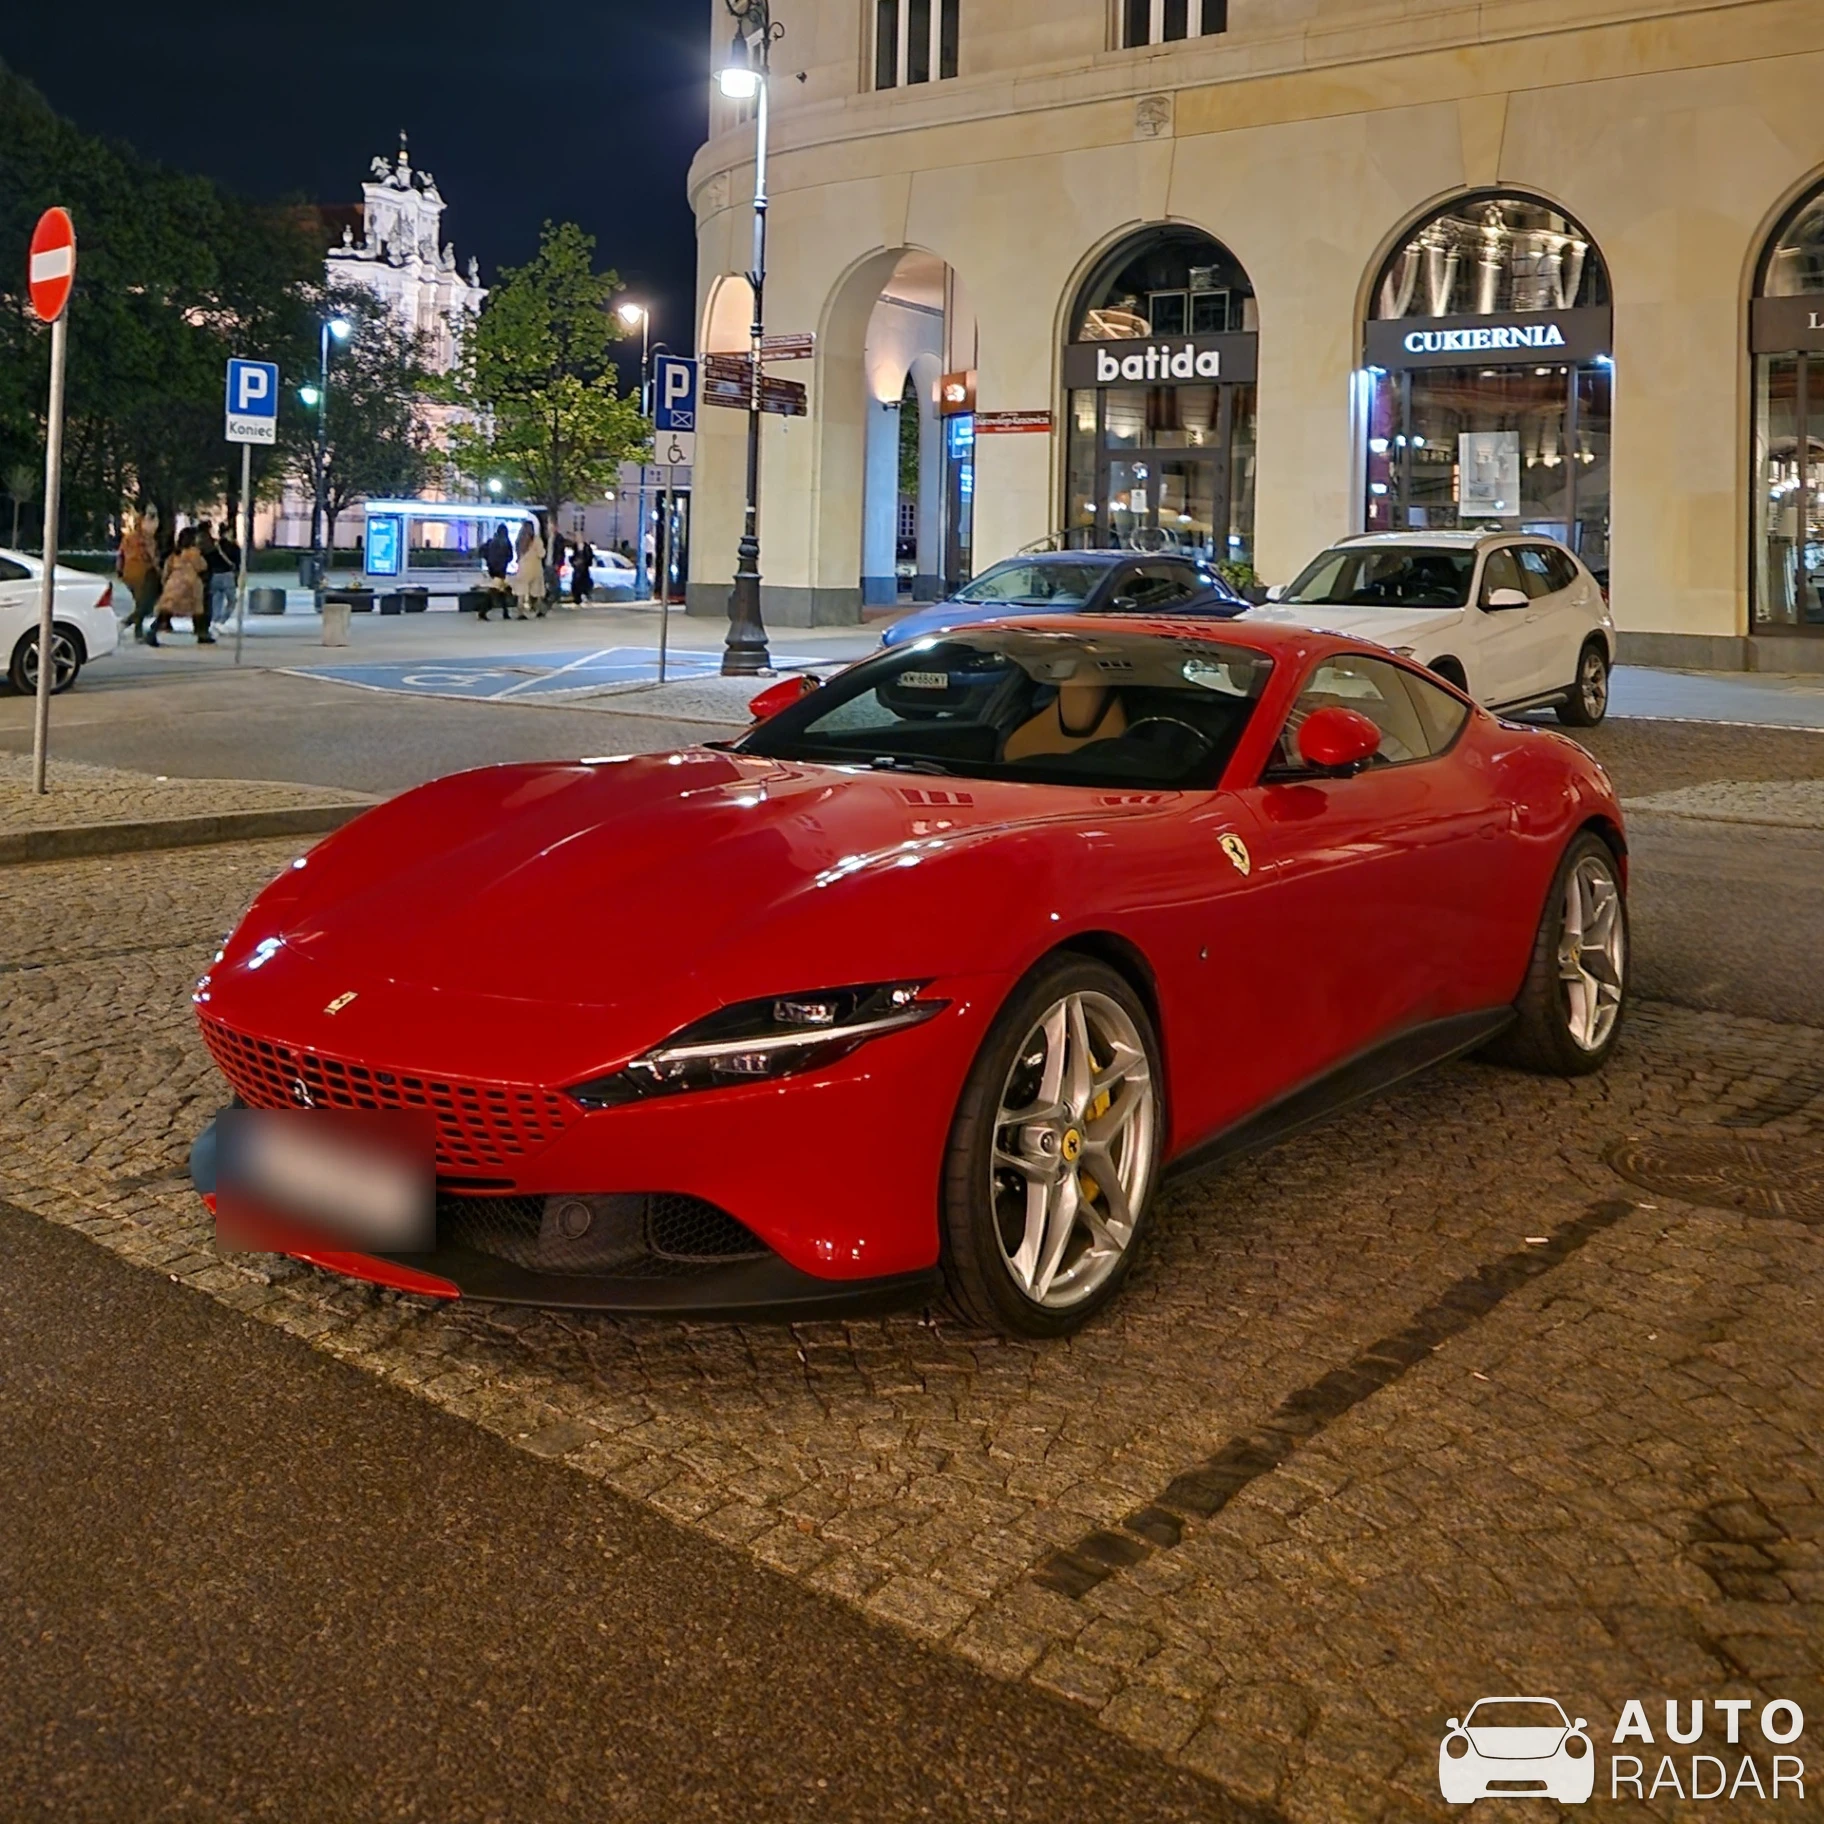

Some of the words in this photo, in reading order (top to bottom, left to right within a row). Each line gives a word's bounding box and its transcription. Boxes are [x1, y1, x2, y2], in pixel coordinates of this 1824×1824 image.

[1405, 324, 1566, 353] CUKIERNIA
[1097, 343, 1220, 382] batida
[239, 366, 268, 409] P
[665, 363, 690, 410] P
[229, 421, 273, 437] Koniec
